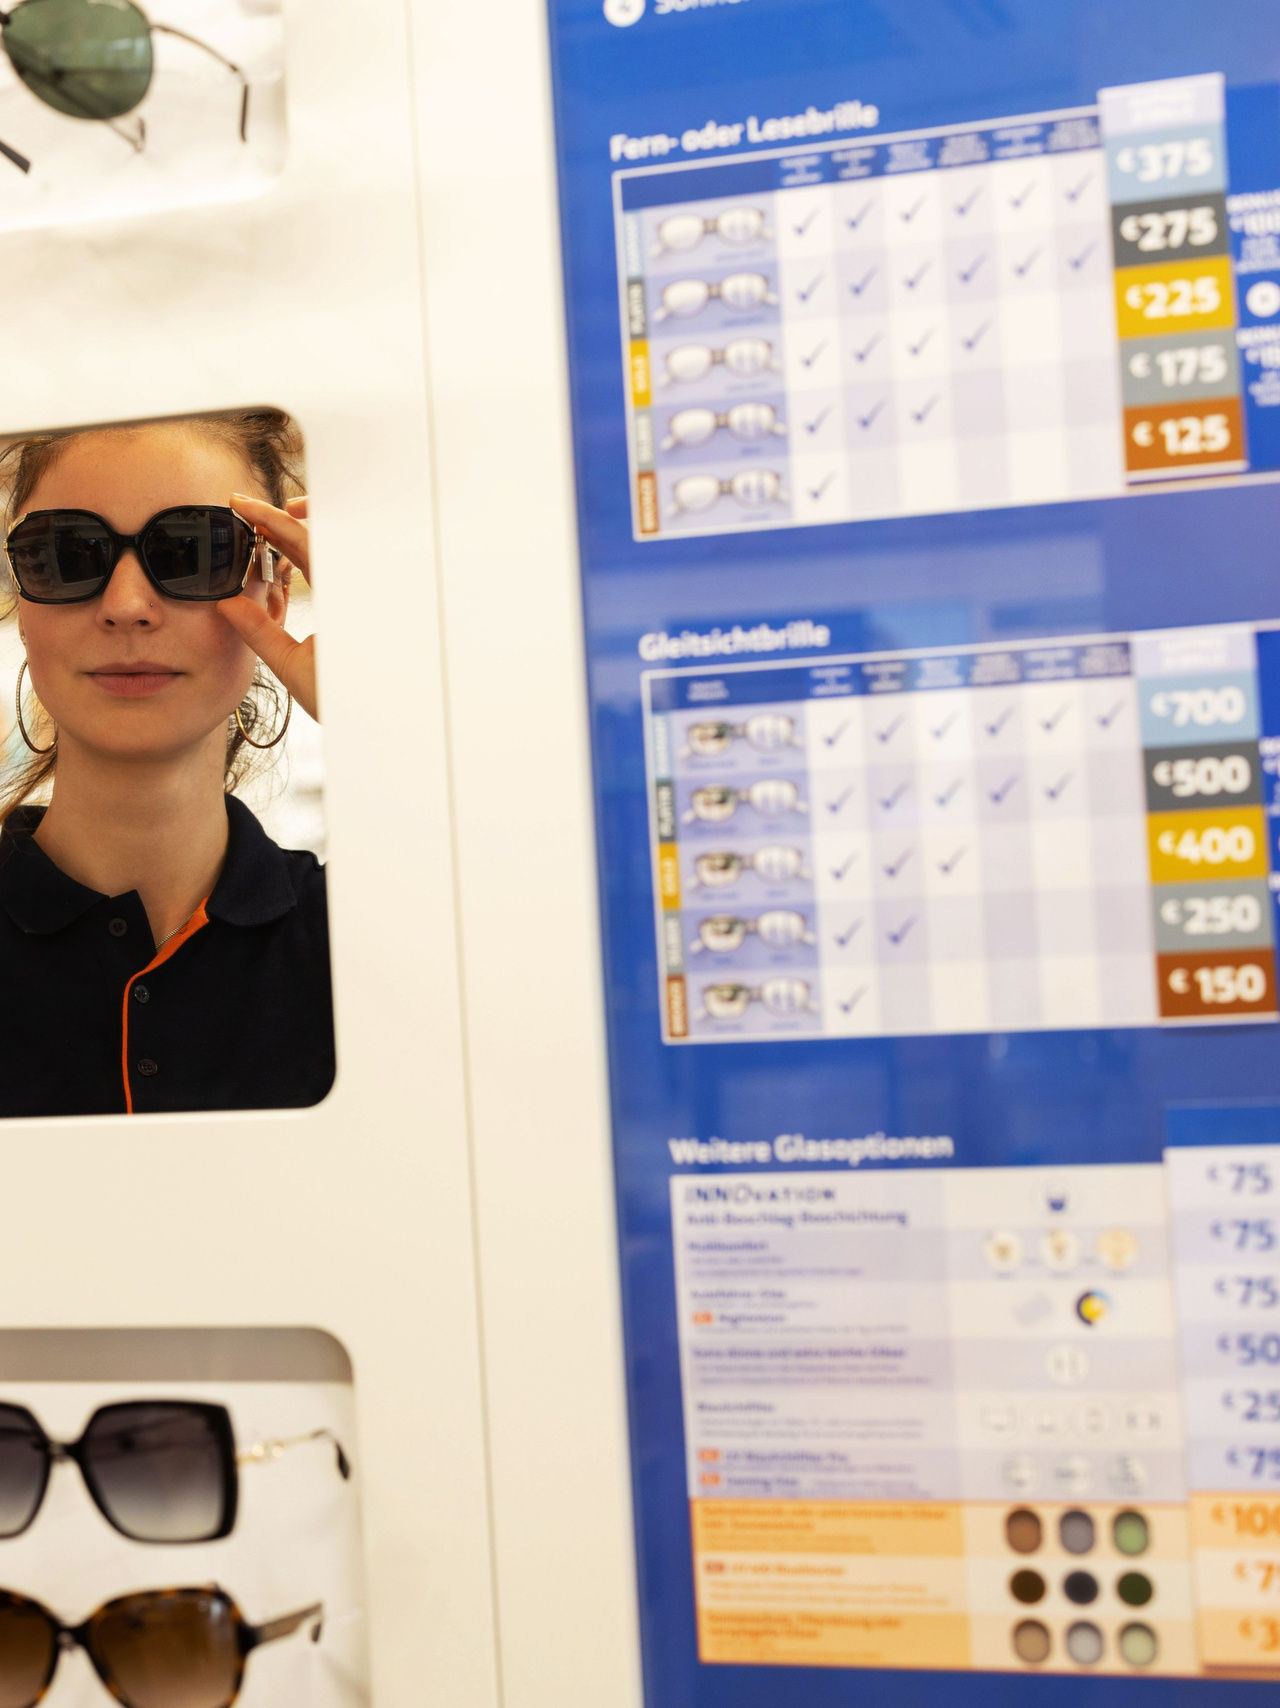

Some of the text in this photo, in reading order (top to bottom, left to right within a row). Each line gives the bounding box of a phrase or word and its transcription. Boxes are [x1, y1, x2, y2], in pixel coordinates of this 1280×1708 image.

[610, 99, 879, 162] Fern- oder Lesebrille
[639, 621, 830, 660] Gleitsichtbrille
[668, 1132, 954, 1167] Weitere Glasoptionen
